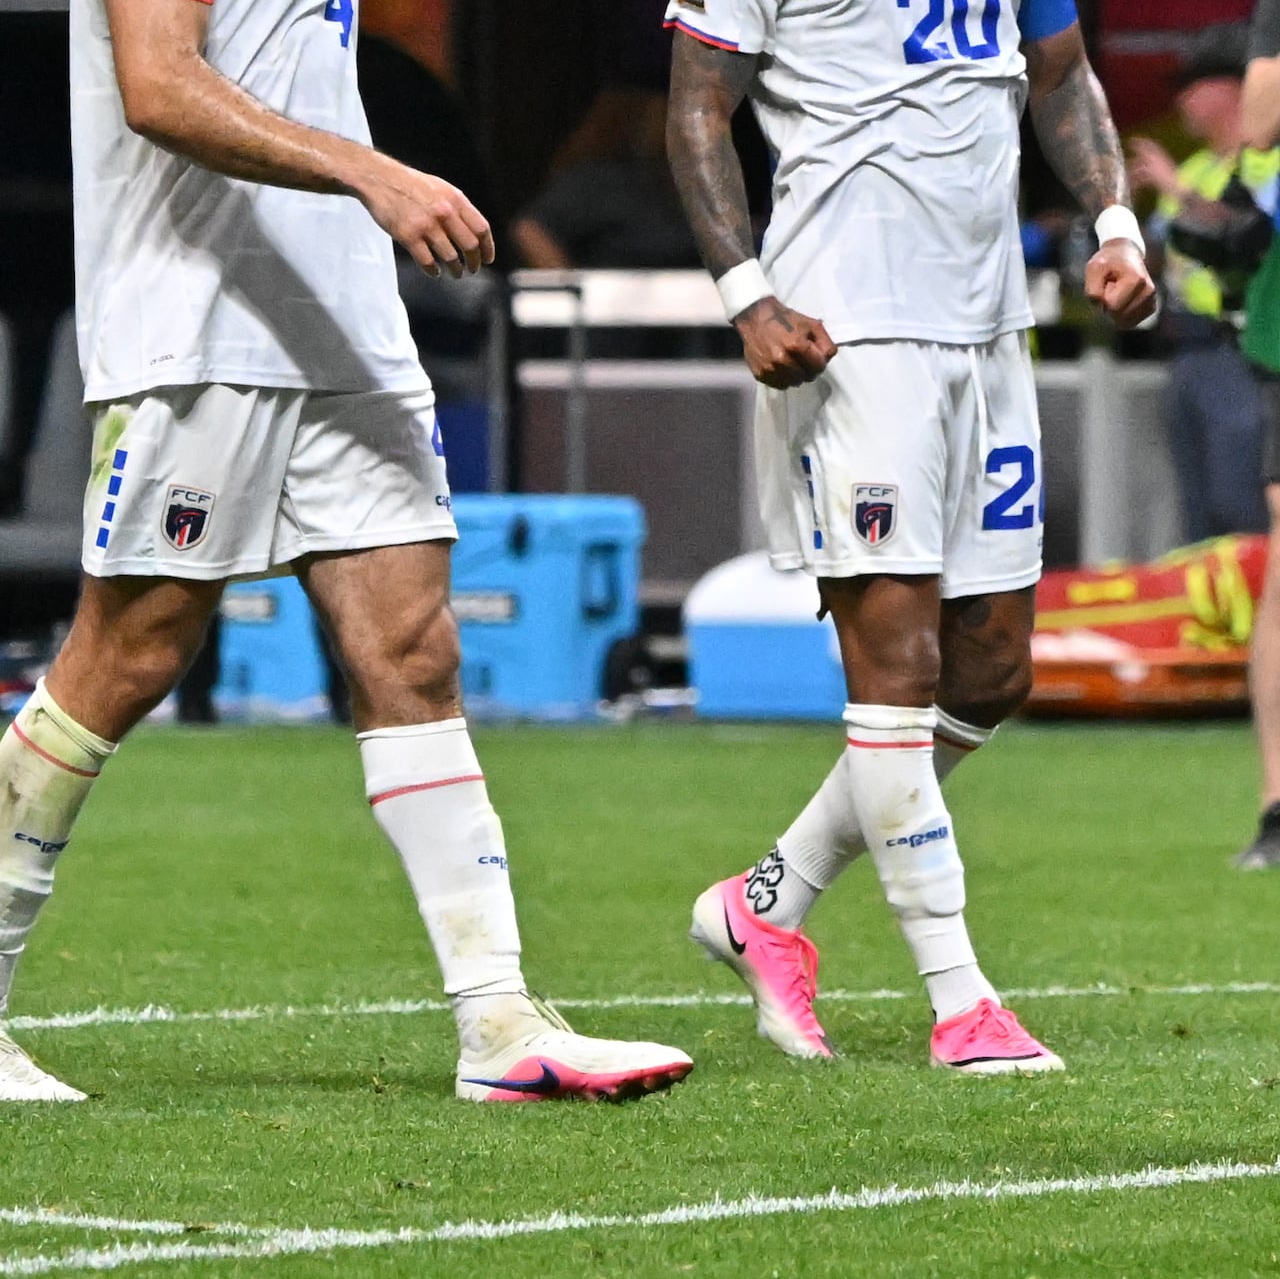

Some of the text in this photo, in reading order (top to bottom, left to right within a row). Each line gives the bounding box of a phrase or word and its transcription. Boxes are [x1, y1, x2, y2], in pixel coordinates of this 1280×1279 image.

[855, 486, 895, 497] FCF
[982, 445, 1045, 530] 2
[171, 488, 213, 504] FCF
